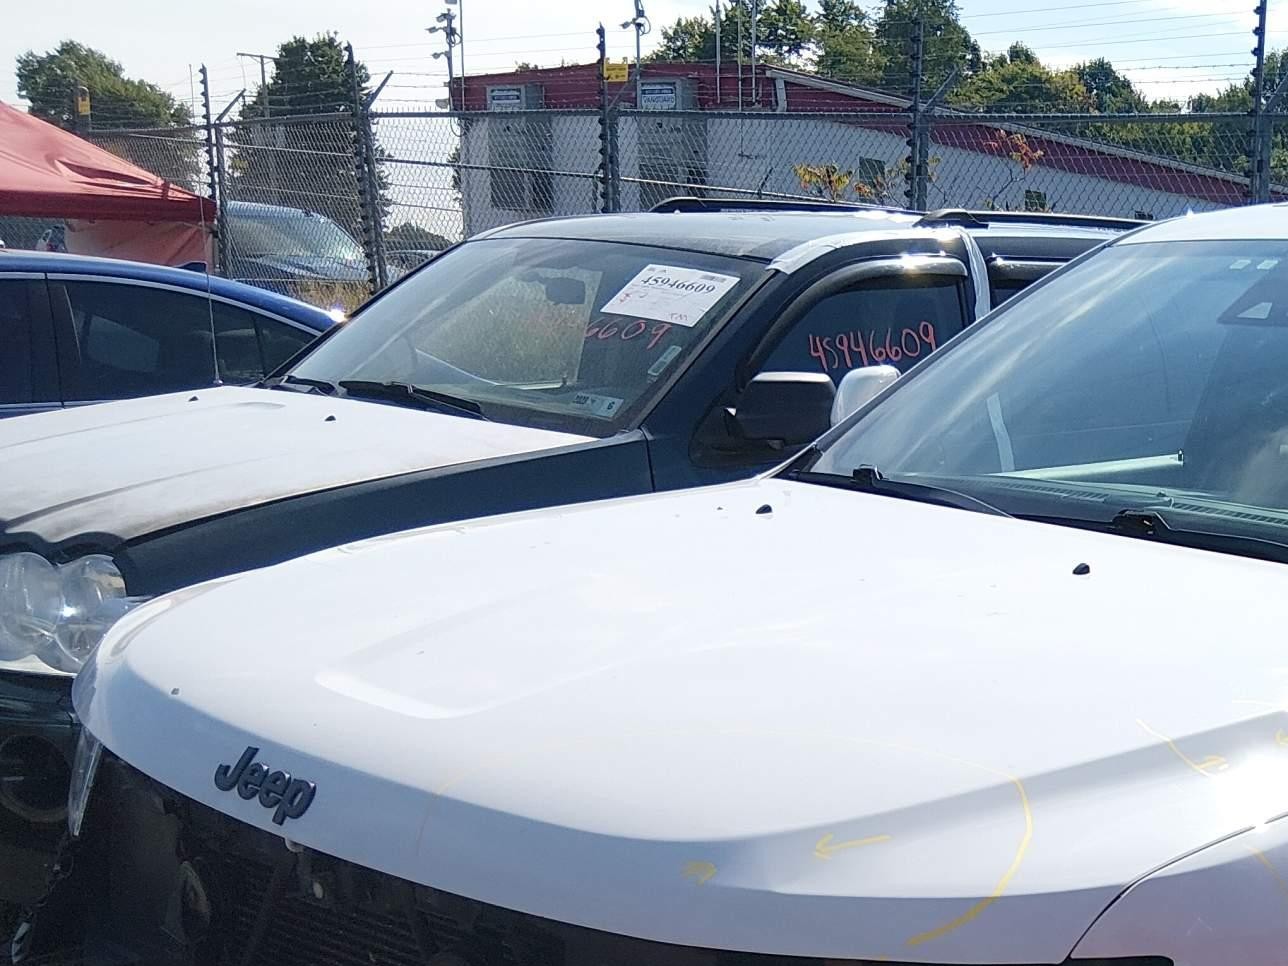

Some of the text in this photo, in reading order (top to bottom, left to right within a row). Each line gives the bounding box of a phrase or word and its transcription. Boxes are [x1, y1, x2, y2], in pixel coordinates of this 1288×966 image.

[641, 275, 716, 294] 45946609
[809, 320, 937, 372] 45946609
[214, 746, 317, 826] Jeep
